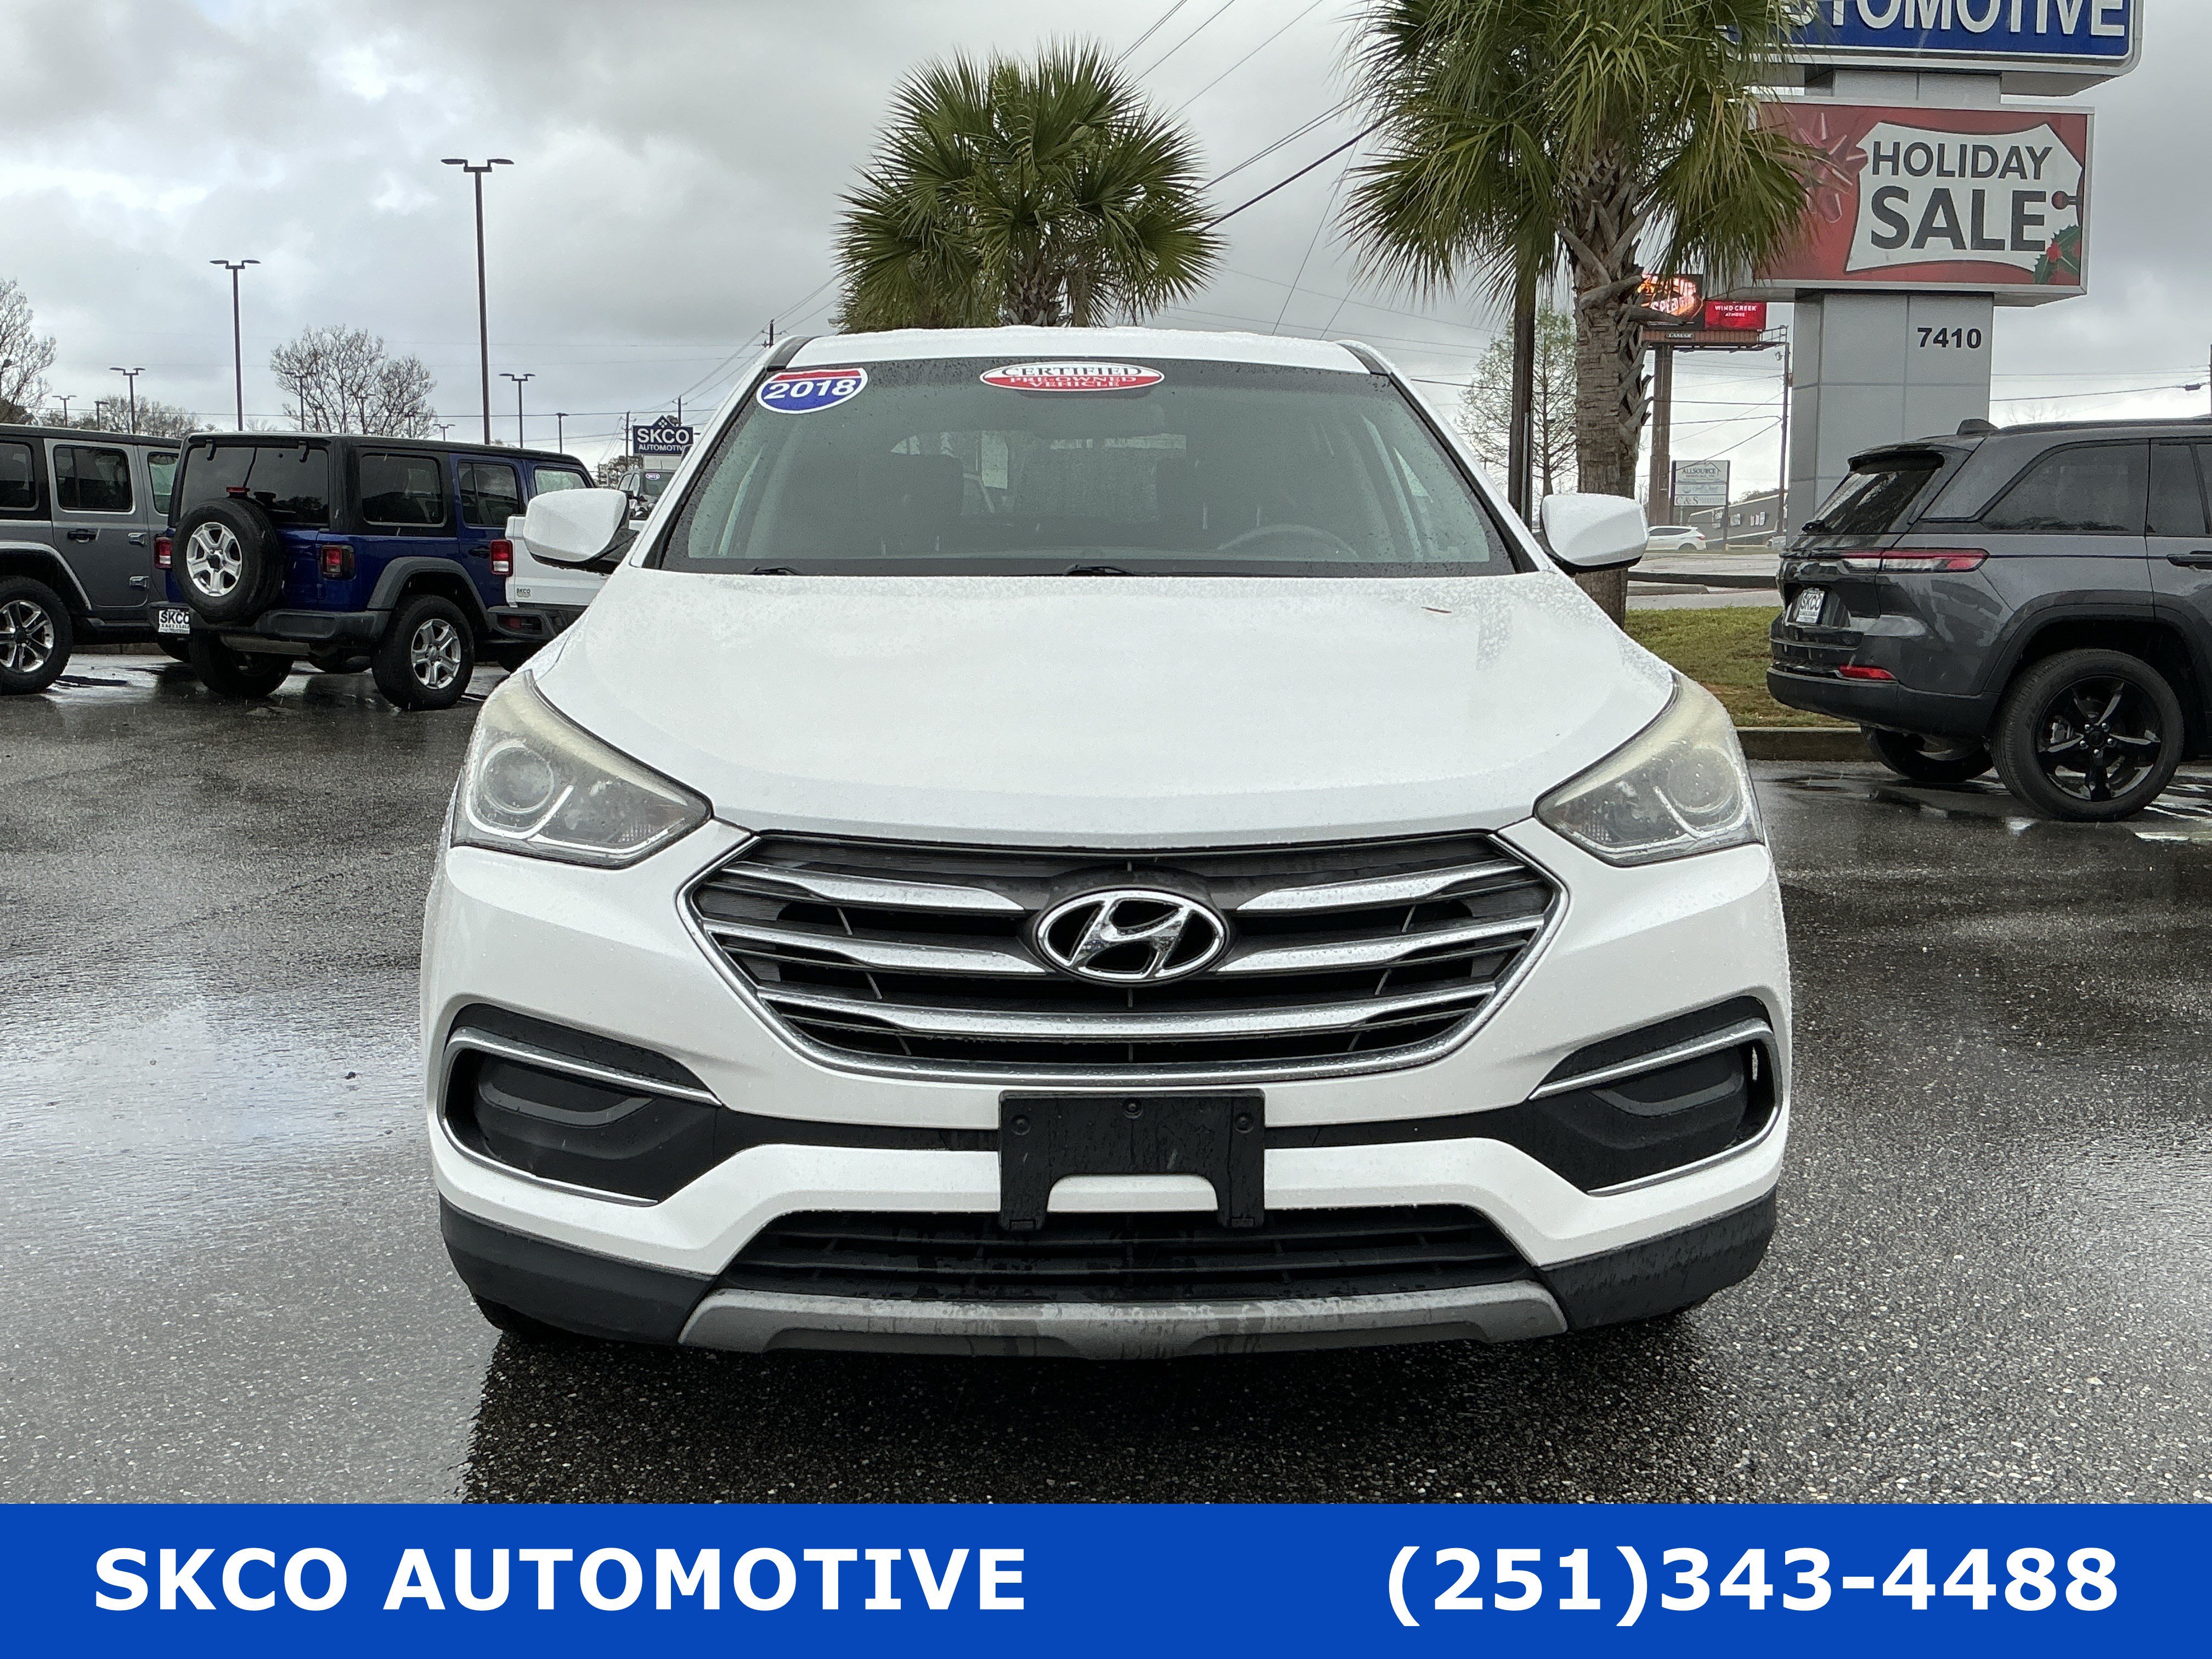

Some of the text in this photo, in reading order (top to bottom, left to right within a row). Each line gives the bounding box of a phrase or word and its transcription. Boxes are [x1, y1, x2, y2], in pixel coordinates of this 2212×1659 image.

[1871, 141, 2053, 180] HOLIDAY
[1871, 185, 2046, 251] SALE
[1917, 327, 1982, 349] 7410
[1001, 367, 1142, 376] CERTIFIED
[763, 379, 856, 400] 2018
[637, 428, 690, 444] SKCO
[639, 444, 686, 452] AUTOMOTIV
[1799, 592, 1822, 611] SKCO
[160, 610, 191, 624] SKCO
